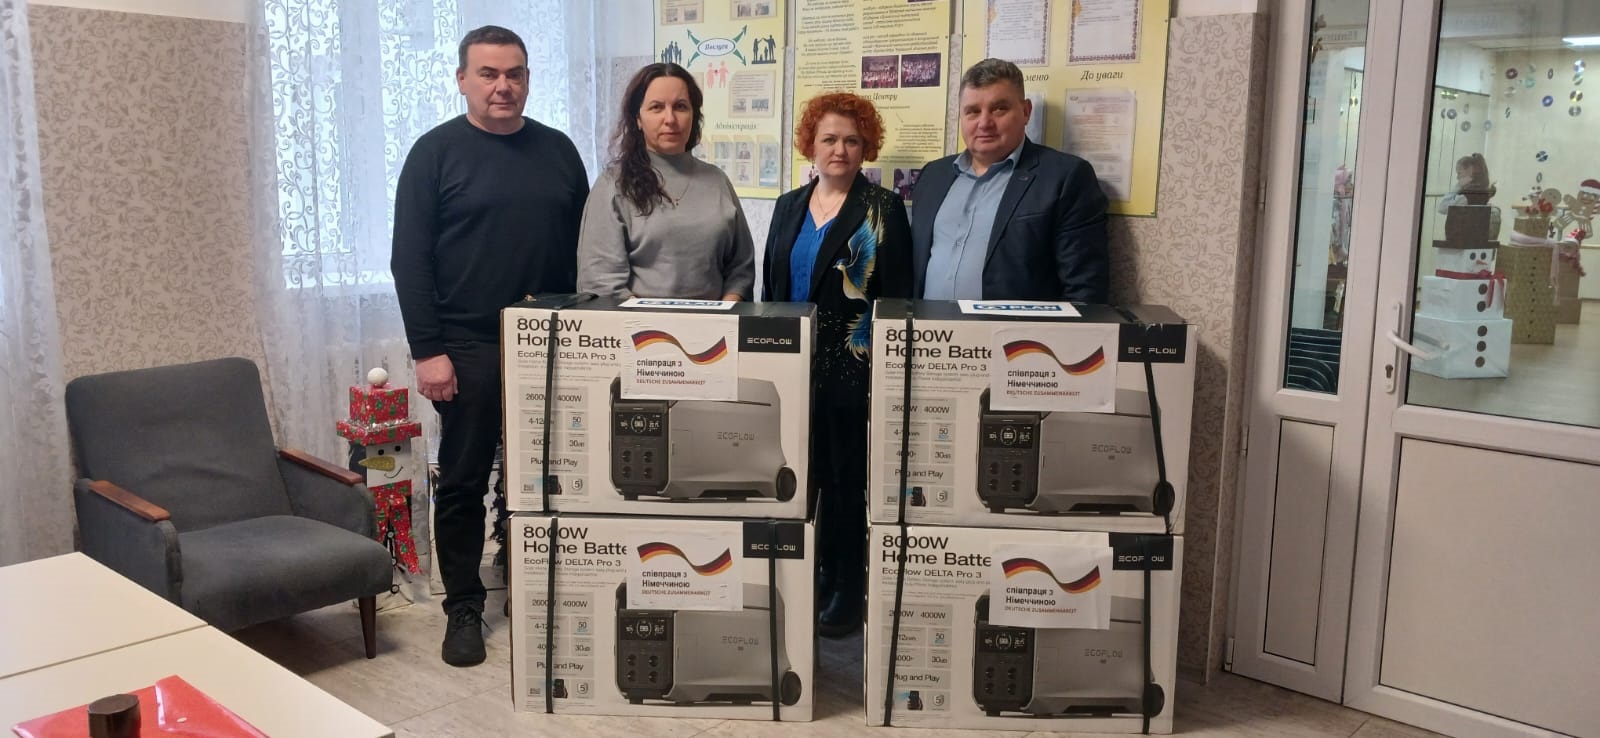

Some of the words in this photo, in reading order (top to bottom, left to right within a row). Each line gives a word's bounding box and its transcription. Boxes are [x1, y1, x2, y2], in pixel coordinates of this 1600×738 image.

[1025, 74, 1049, 82] меню
[1081, 71, 1094, 81] До
[1096, 71, 1124, 82] уваги
[517, 333, 572, 347] Home
[746, 336, 793, 345] ECOFLOW
[886, 328, 954, 343] 8000W
[517, 350, 557, 359] EcoFlo
[560, 351, 589, 360] DELTA
[591, 352, 607, 361] Pro
[609, 353, 617, 361] 3
[1127, 346, 1177, 355] ECFLOW
[636, 358, 677, 369] співпраця
[928, 362, 958, 371] DELTA
[960, 363, 978, 371] Pro
[636, 368, 685, 378] Німеччиною
[1007, 368, 1050, 379] співпраця
[1007, 379, 1059, 389] Німеччиною
[525, 392, 546, 401] 2600
[891, 404, 918, 413] 260W
[923, 406, 951, 414] 4000W
[938, 427, 949, 435] 50
[530, 457, 545, 466] Plu
[563, 458, 579, 468] Play
[912, 470, 927, 478] and
[927, 470, 944, 480] Play
[523, 540, 578, 554] Home
[751, 543, 796, 551] ECOLOW
[523, 557, 563, 566] EcoFlw
[565, 558, 594, 566] DELTA
[596, 559, 613, 567] Pro
[614, 559, 622, 567] 3
[641, 570, 682, 579] співпраця
[882, 567, 922, 576] Ecolow
[924, 569, 954, 577] DELTA
[956, 570, 973, 578] Pro
[975, 571, 982, 579] 3
[641, 579, 690, 588] Німеччиною
[1006, 586, 1048, 596] співпраця
[562, 600, 588, 608] 4000W
[1006, 595, 1056, 606] Німеччиною
[920, 611, 946, 619] 4000W
[578, 621, 587, 629] 50
[935, 632, 945, 640] 50
[553, 662, 568, 670] and
[568, 662, 584, 671] Play
[925, 674, 940, 684] Play
